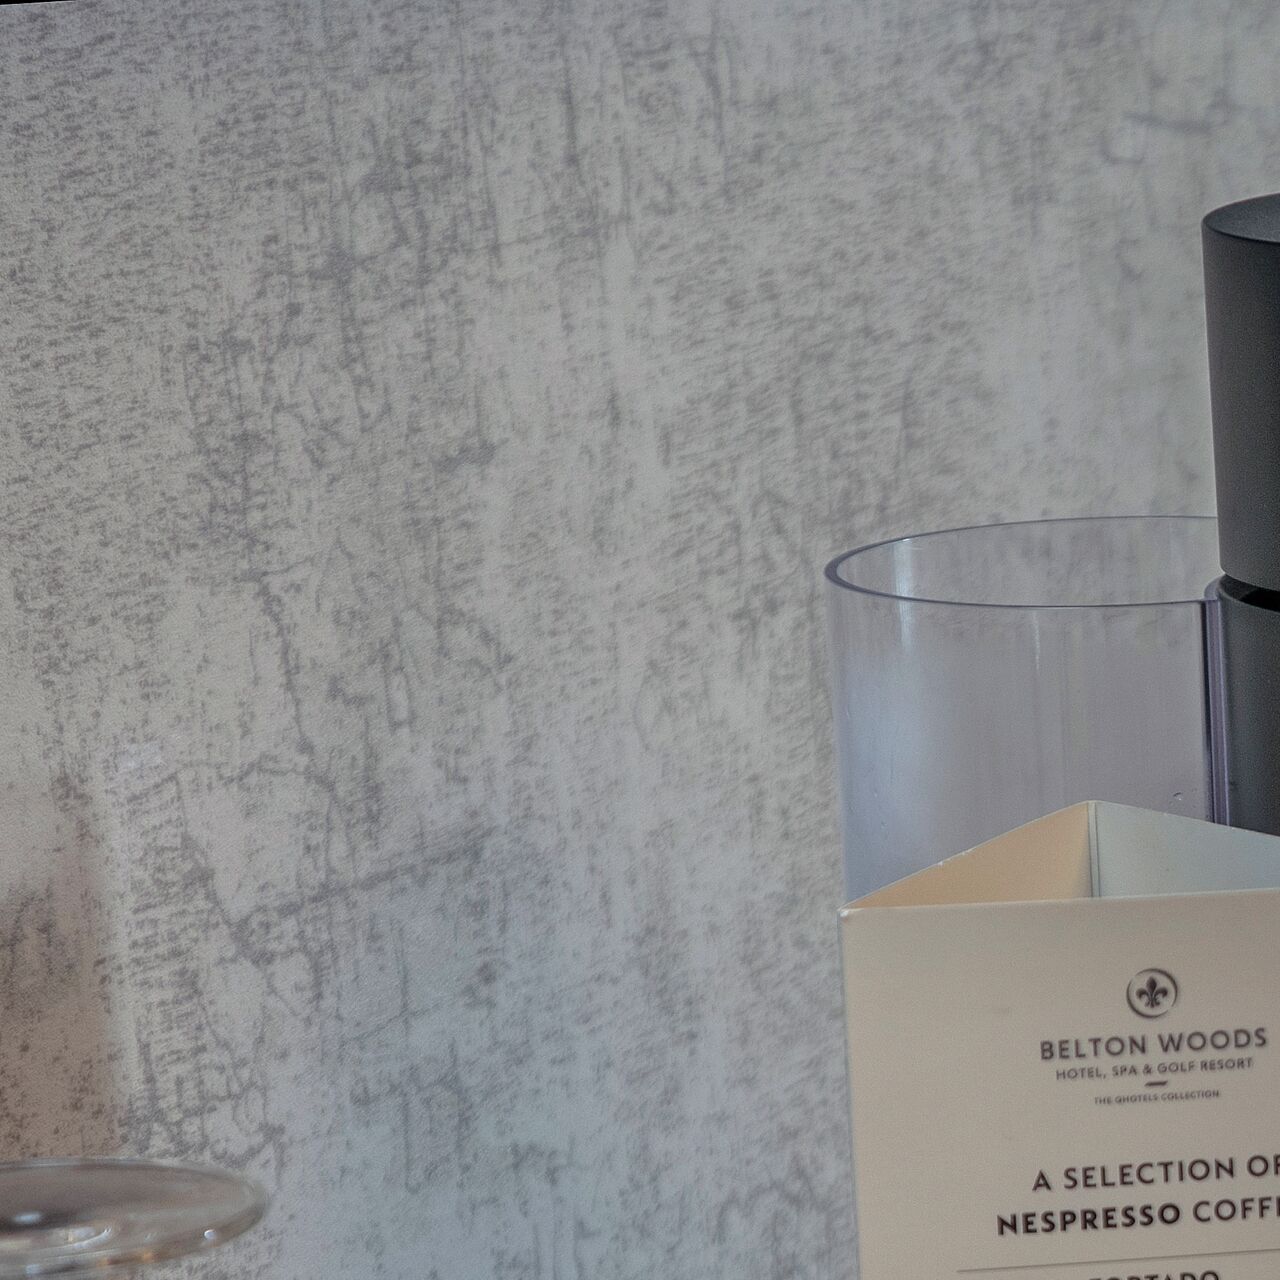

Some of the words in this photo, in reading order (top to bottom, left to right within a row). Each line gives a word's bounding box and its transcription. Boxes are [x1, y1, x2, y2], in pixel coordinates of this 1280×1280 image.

[1040, 1034, 1147, 1060] BELTON
[1157, 1028, 1268, 1053] WOODS
[1056, 1065, 1106, 1081] HOTEL,
[1112, 1063, 1138, 1077] SPA
[1142, 1062, 1153, 1075] &
[1157, 1060, 1196, 1075] GOLF
[1200, 1057, 1253, 1071] RESORT
[1032, 1170, 1052, 1192] A
[1064, 1158, 1235, 1190] SELECTION
[997, 1203, 1181, 1236] NESPRESSO
